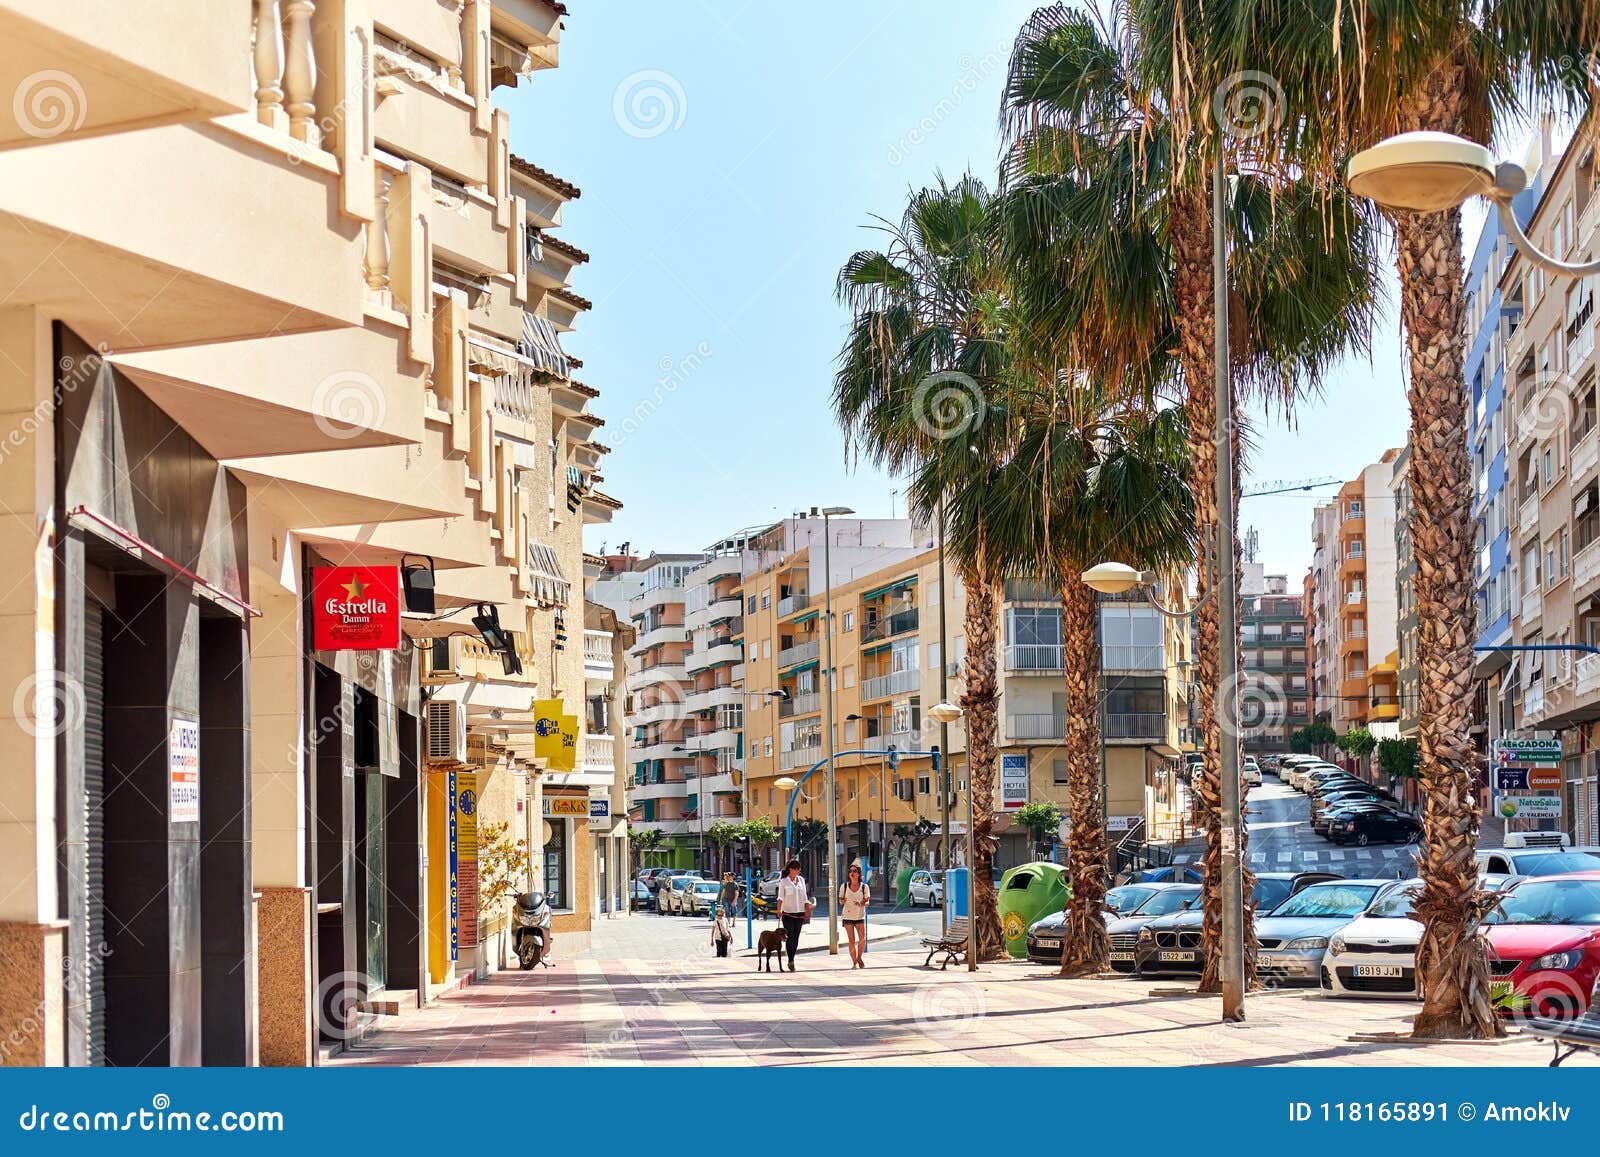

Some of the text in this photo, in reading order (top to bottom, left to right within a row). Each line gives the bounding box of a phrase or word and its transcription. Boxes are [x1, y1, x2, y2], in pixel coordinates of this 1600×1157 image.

[326, 598, 387, 615] Estrella
[343, 615, 370, 624] Damm
[179, 728, 197, 749] VENDE
[1499, 740, 1560, 748] MERCADONA
[1513, 780, 1519, 788] P
[1162, 952, 1193, 960] 5522 JMN
[1359, 967, 1400, 976] 8919 JJW
